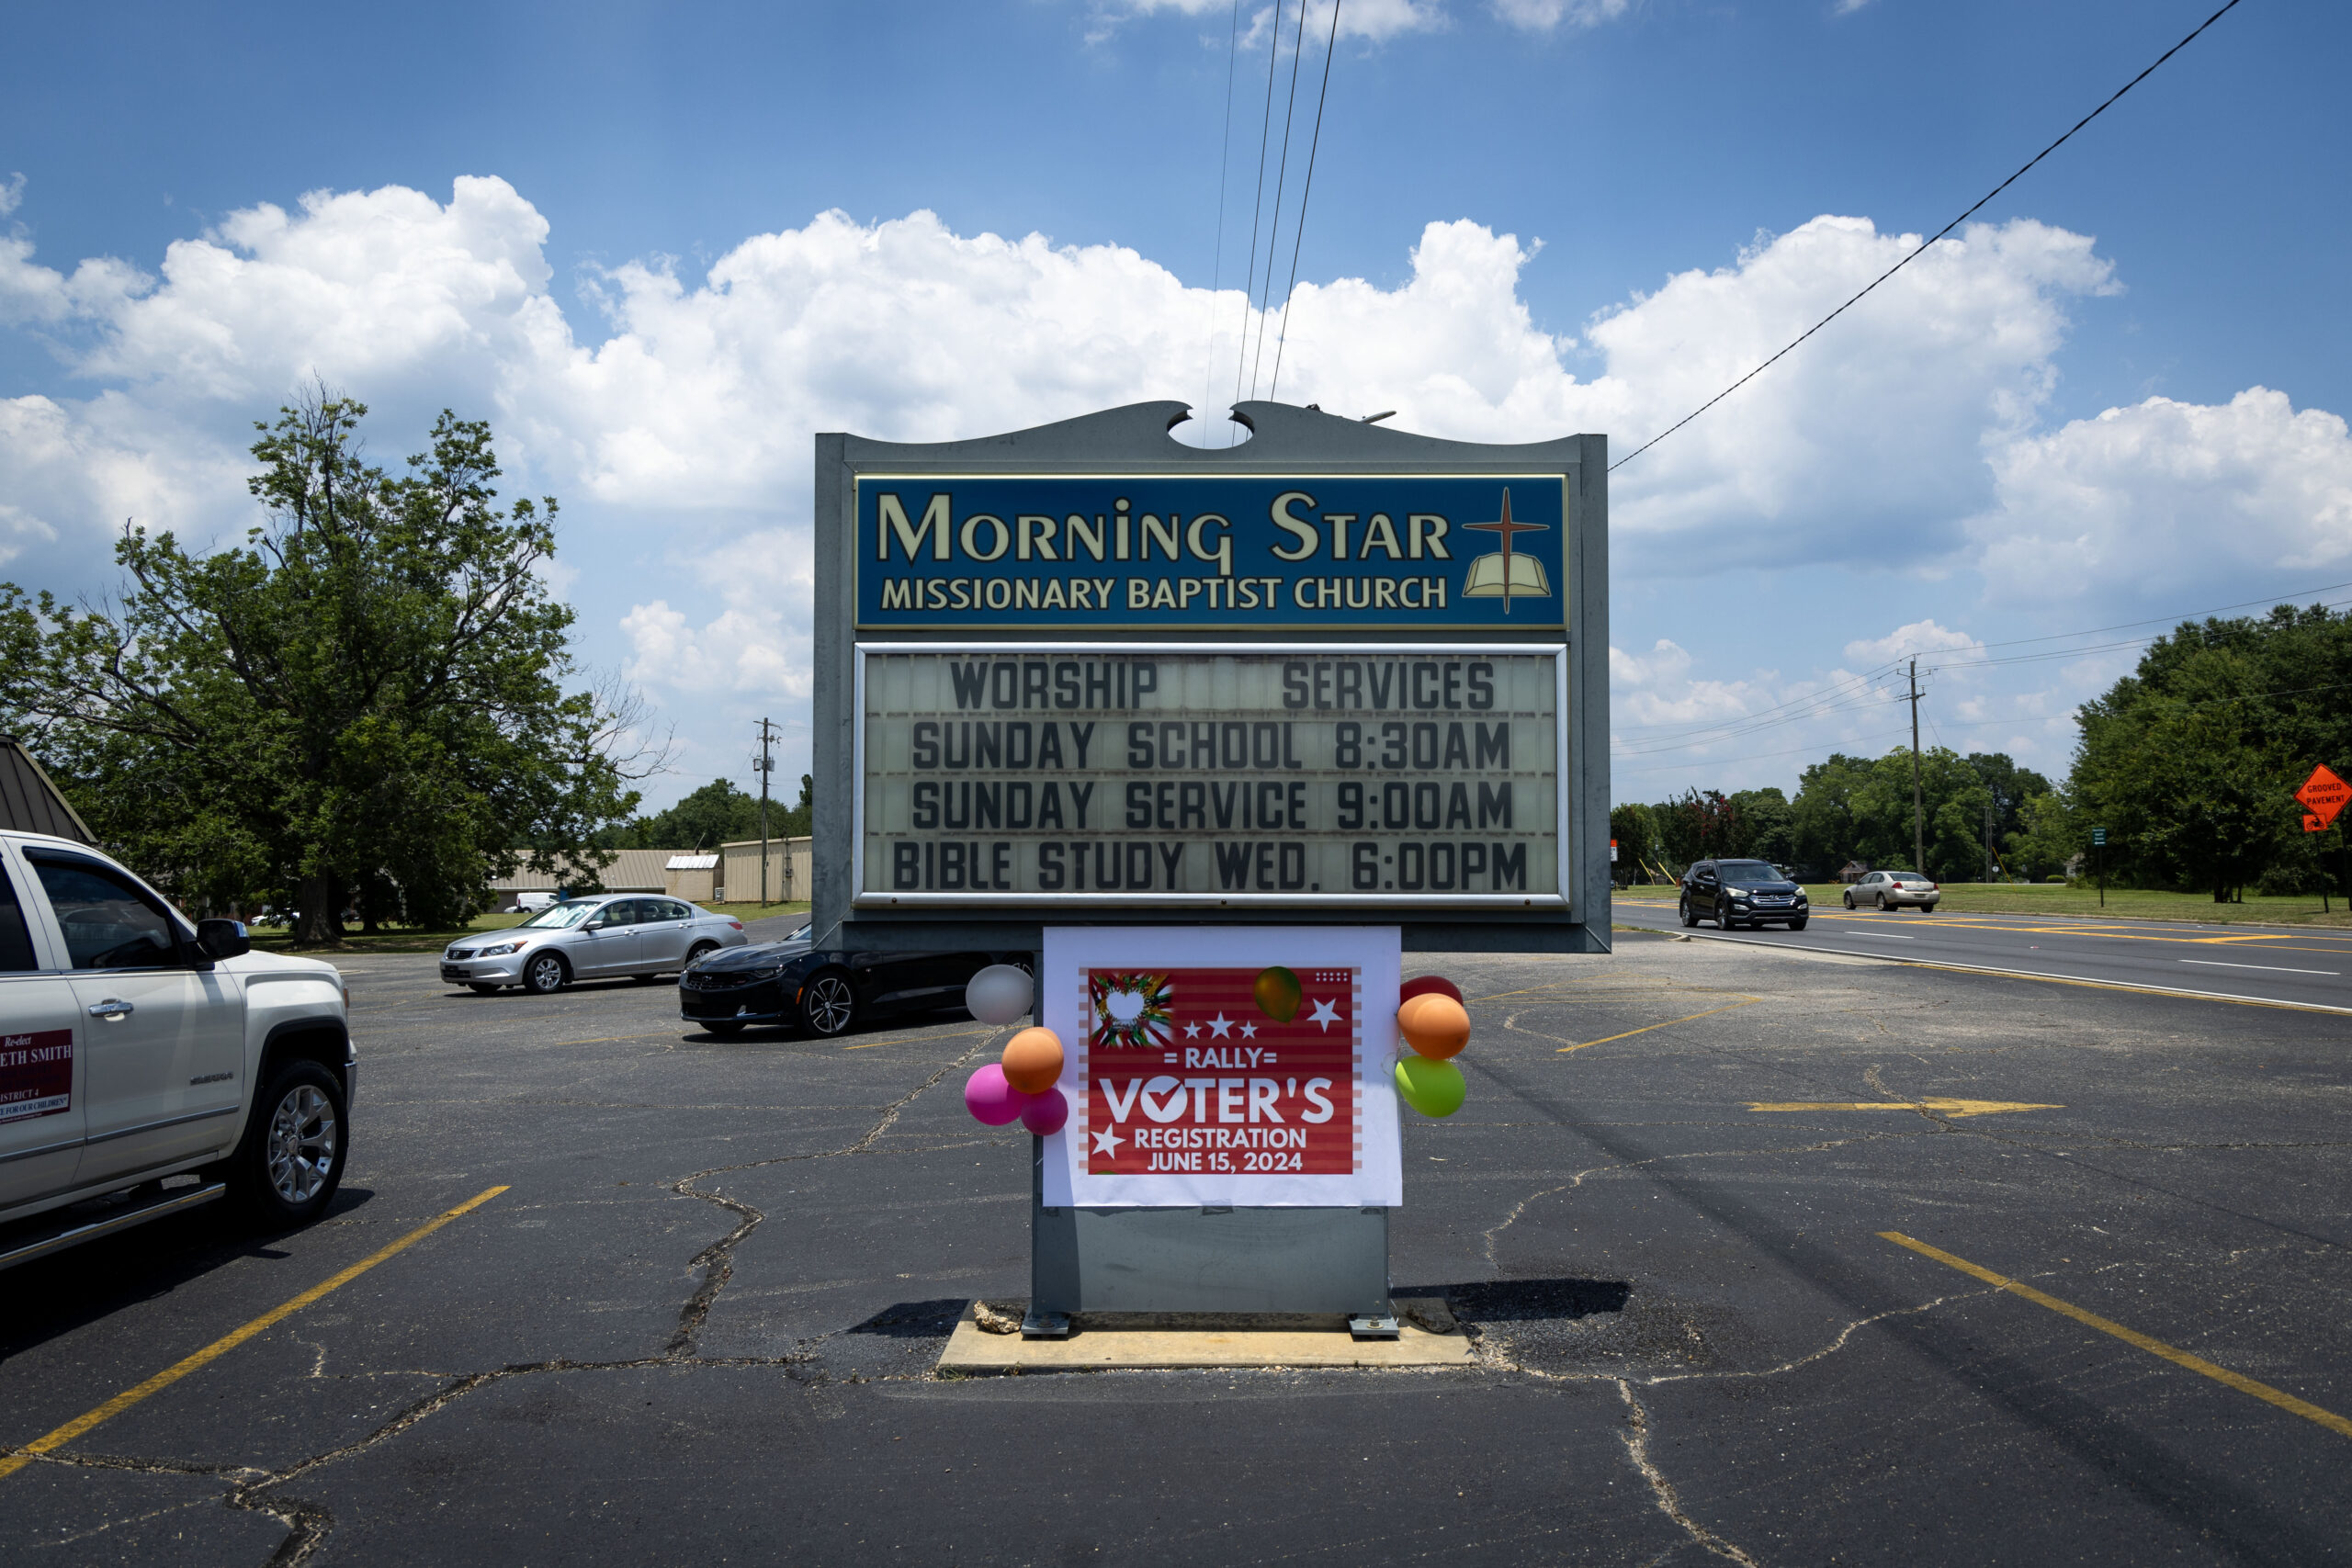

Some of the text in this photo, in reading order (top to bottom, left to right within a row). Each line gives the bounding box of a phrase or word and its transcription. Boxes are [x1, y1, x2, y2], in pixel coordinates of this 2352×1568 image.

[877, 491, 1451, 577] MORNING STAR
[881, 578, 1447, 610] MISSIONARY BAPTIST CHURCH
[951, 661, 1494, 710] WORSHIP SERVICES
[912, 722, 1510, 770] SUNDAY SCHOOL 8:30AM
[2307, 783, 2341, 793] GROOVED
[912, 782, 1512, 830] SUNDAY SERVICE 9:00AM
[2306, 795, 2345, 805] PAVEMENT
[894, 841, 1527, 893] BIBLE STUDY WED. 6:00PM
[5, 1036, 31, 1047] Re-elect
[30, 1044, 72, 1063] SMITH
[34, 1089, 40, 1097] 4
[1099, 1075, 1335, 1124] VOTER'S
[6, 1105, 19, 1115] FOR
[19, 1102, 34, 1112] OUR
[1135, 1128, 1307, 1149] REGISTRATION
[1147, 1151, 1304, 1174] JUNE 15, 2024
